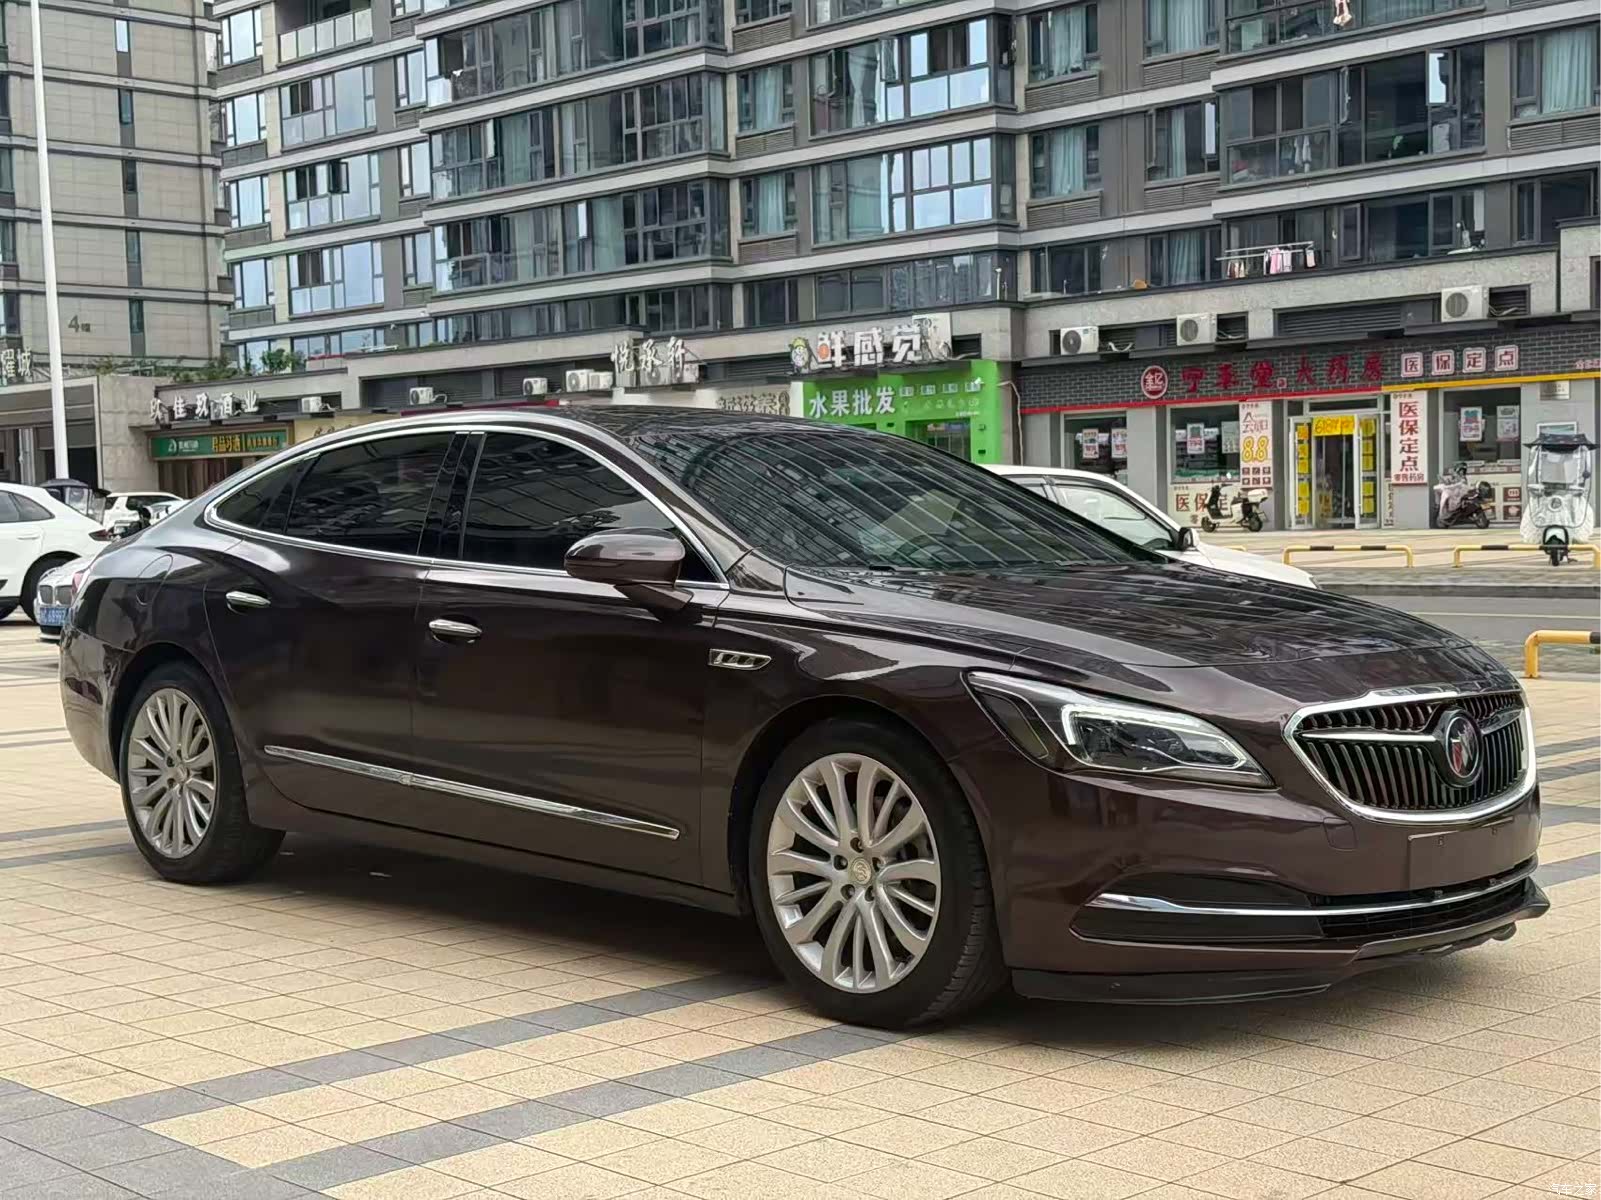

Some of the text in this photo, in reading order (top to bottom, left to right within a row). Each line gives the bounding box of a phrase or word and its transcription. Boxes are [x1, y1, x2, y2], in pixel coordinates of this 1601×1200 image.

[68, 315, 91, 333] 4
[812, 325, 922, 370] 鲜感觉
[1404, 350, 1515, 373] 医保定点
[810, 386, 896, 418] 水果批发
[1398, 400, 1419, 472] 医保定点
